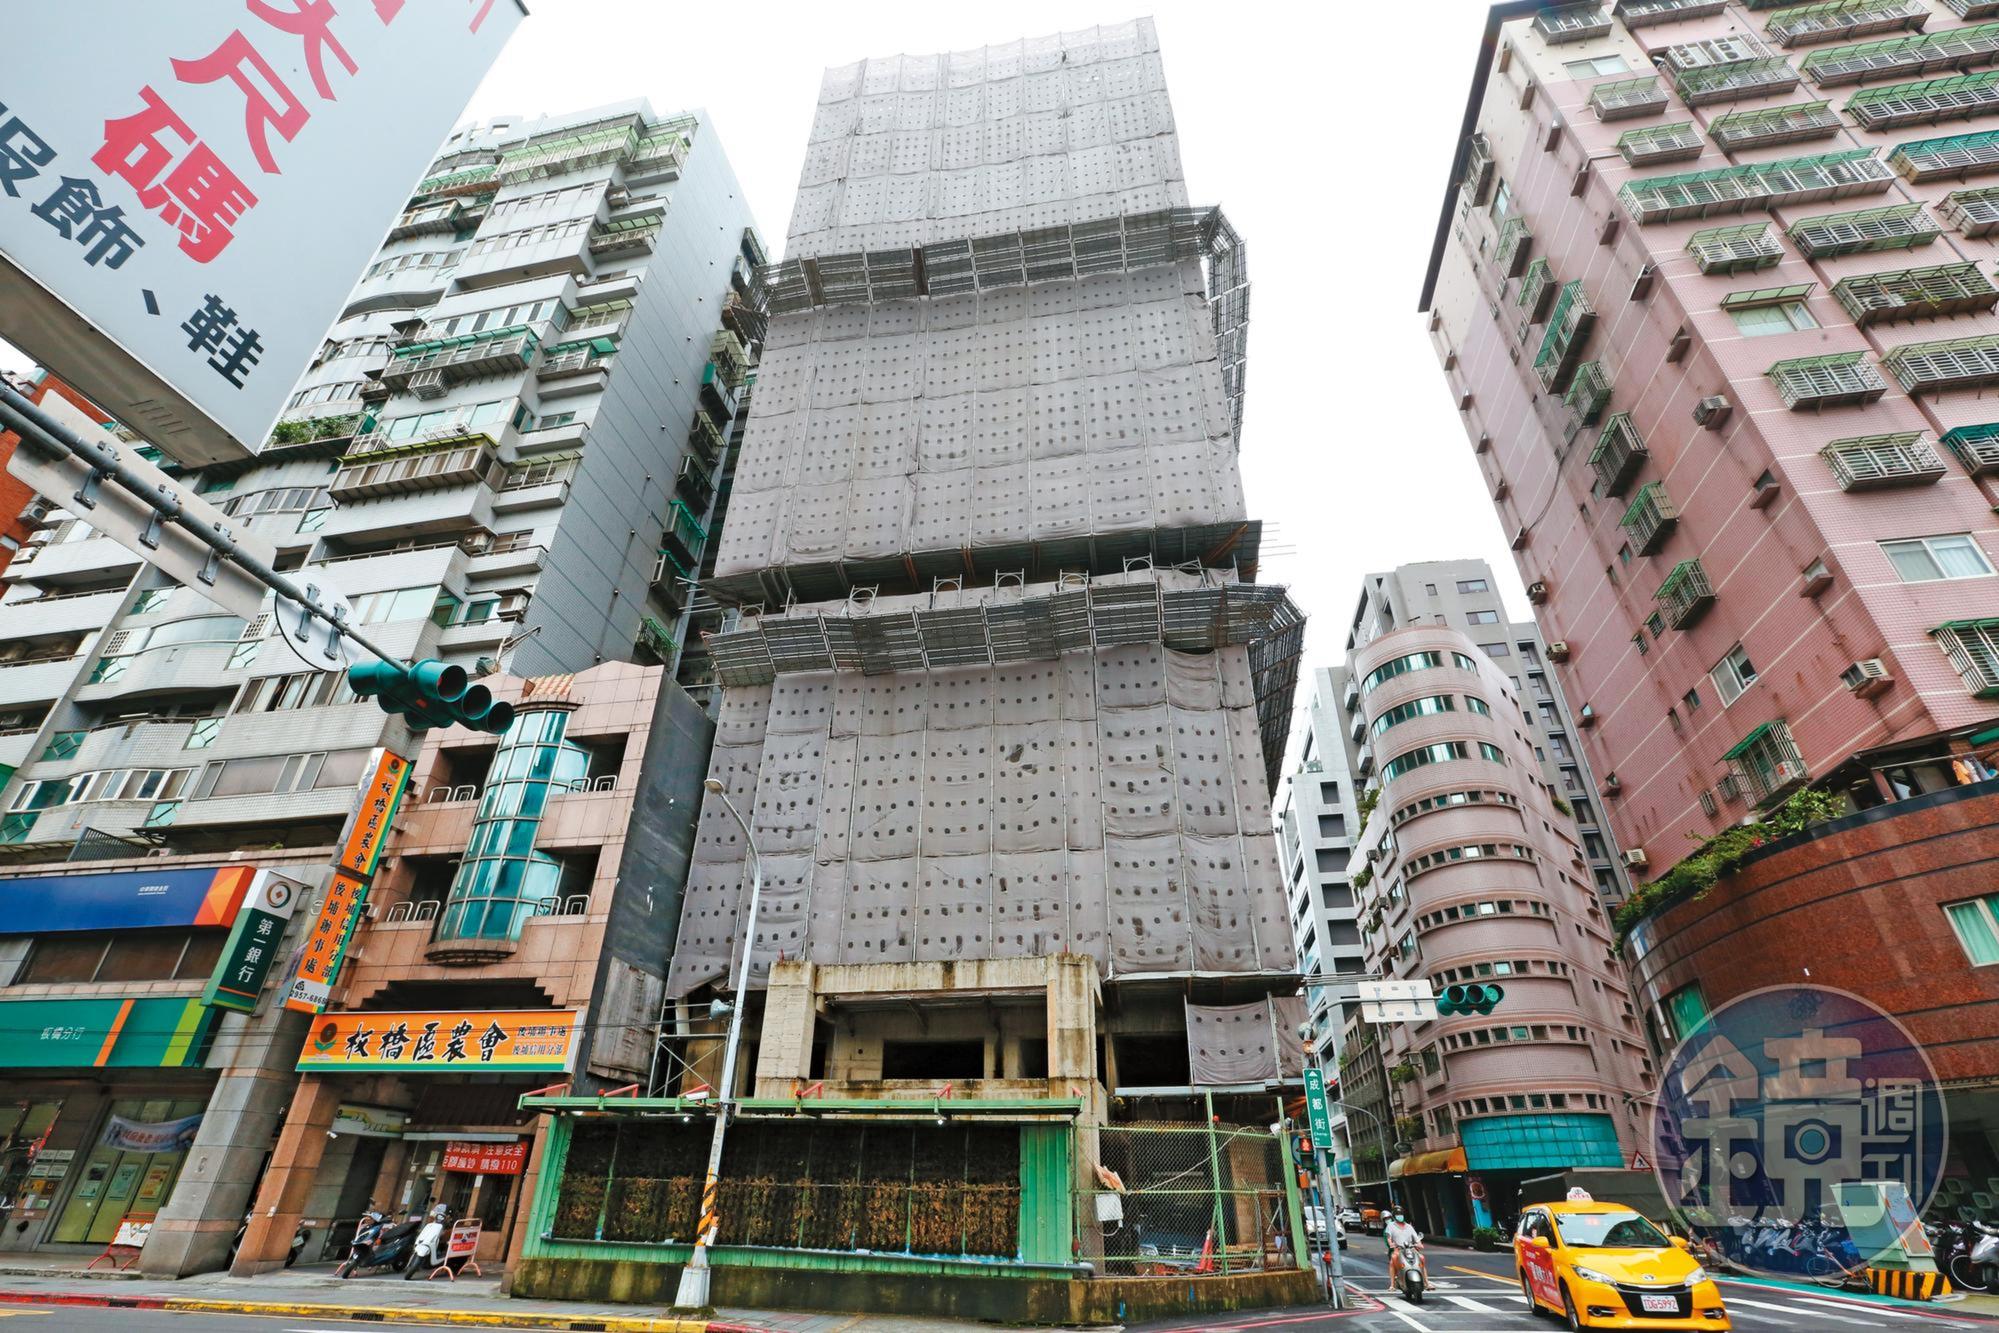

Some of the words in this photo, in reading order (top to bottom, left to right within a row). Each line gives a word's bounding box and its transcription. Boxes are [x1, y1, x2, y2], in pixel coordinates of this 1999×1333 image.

[91, 0, 402, 263] 大尺碼
[354, 781, 393, 869] 板橋區農會
[238, 918, 274, 983] 第一銀行
[40, 1026, 86, 1040] 板橋分行
[345, 1020, 509, 1063] 板橋區農會
[1309, 1079, 1325, 1130] 成都街
